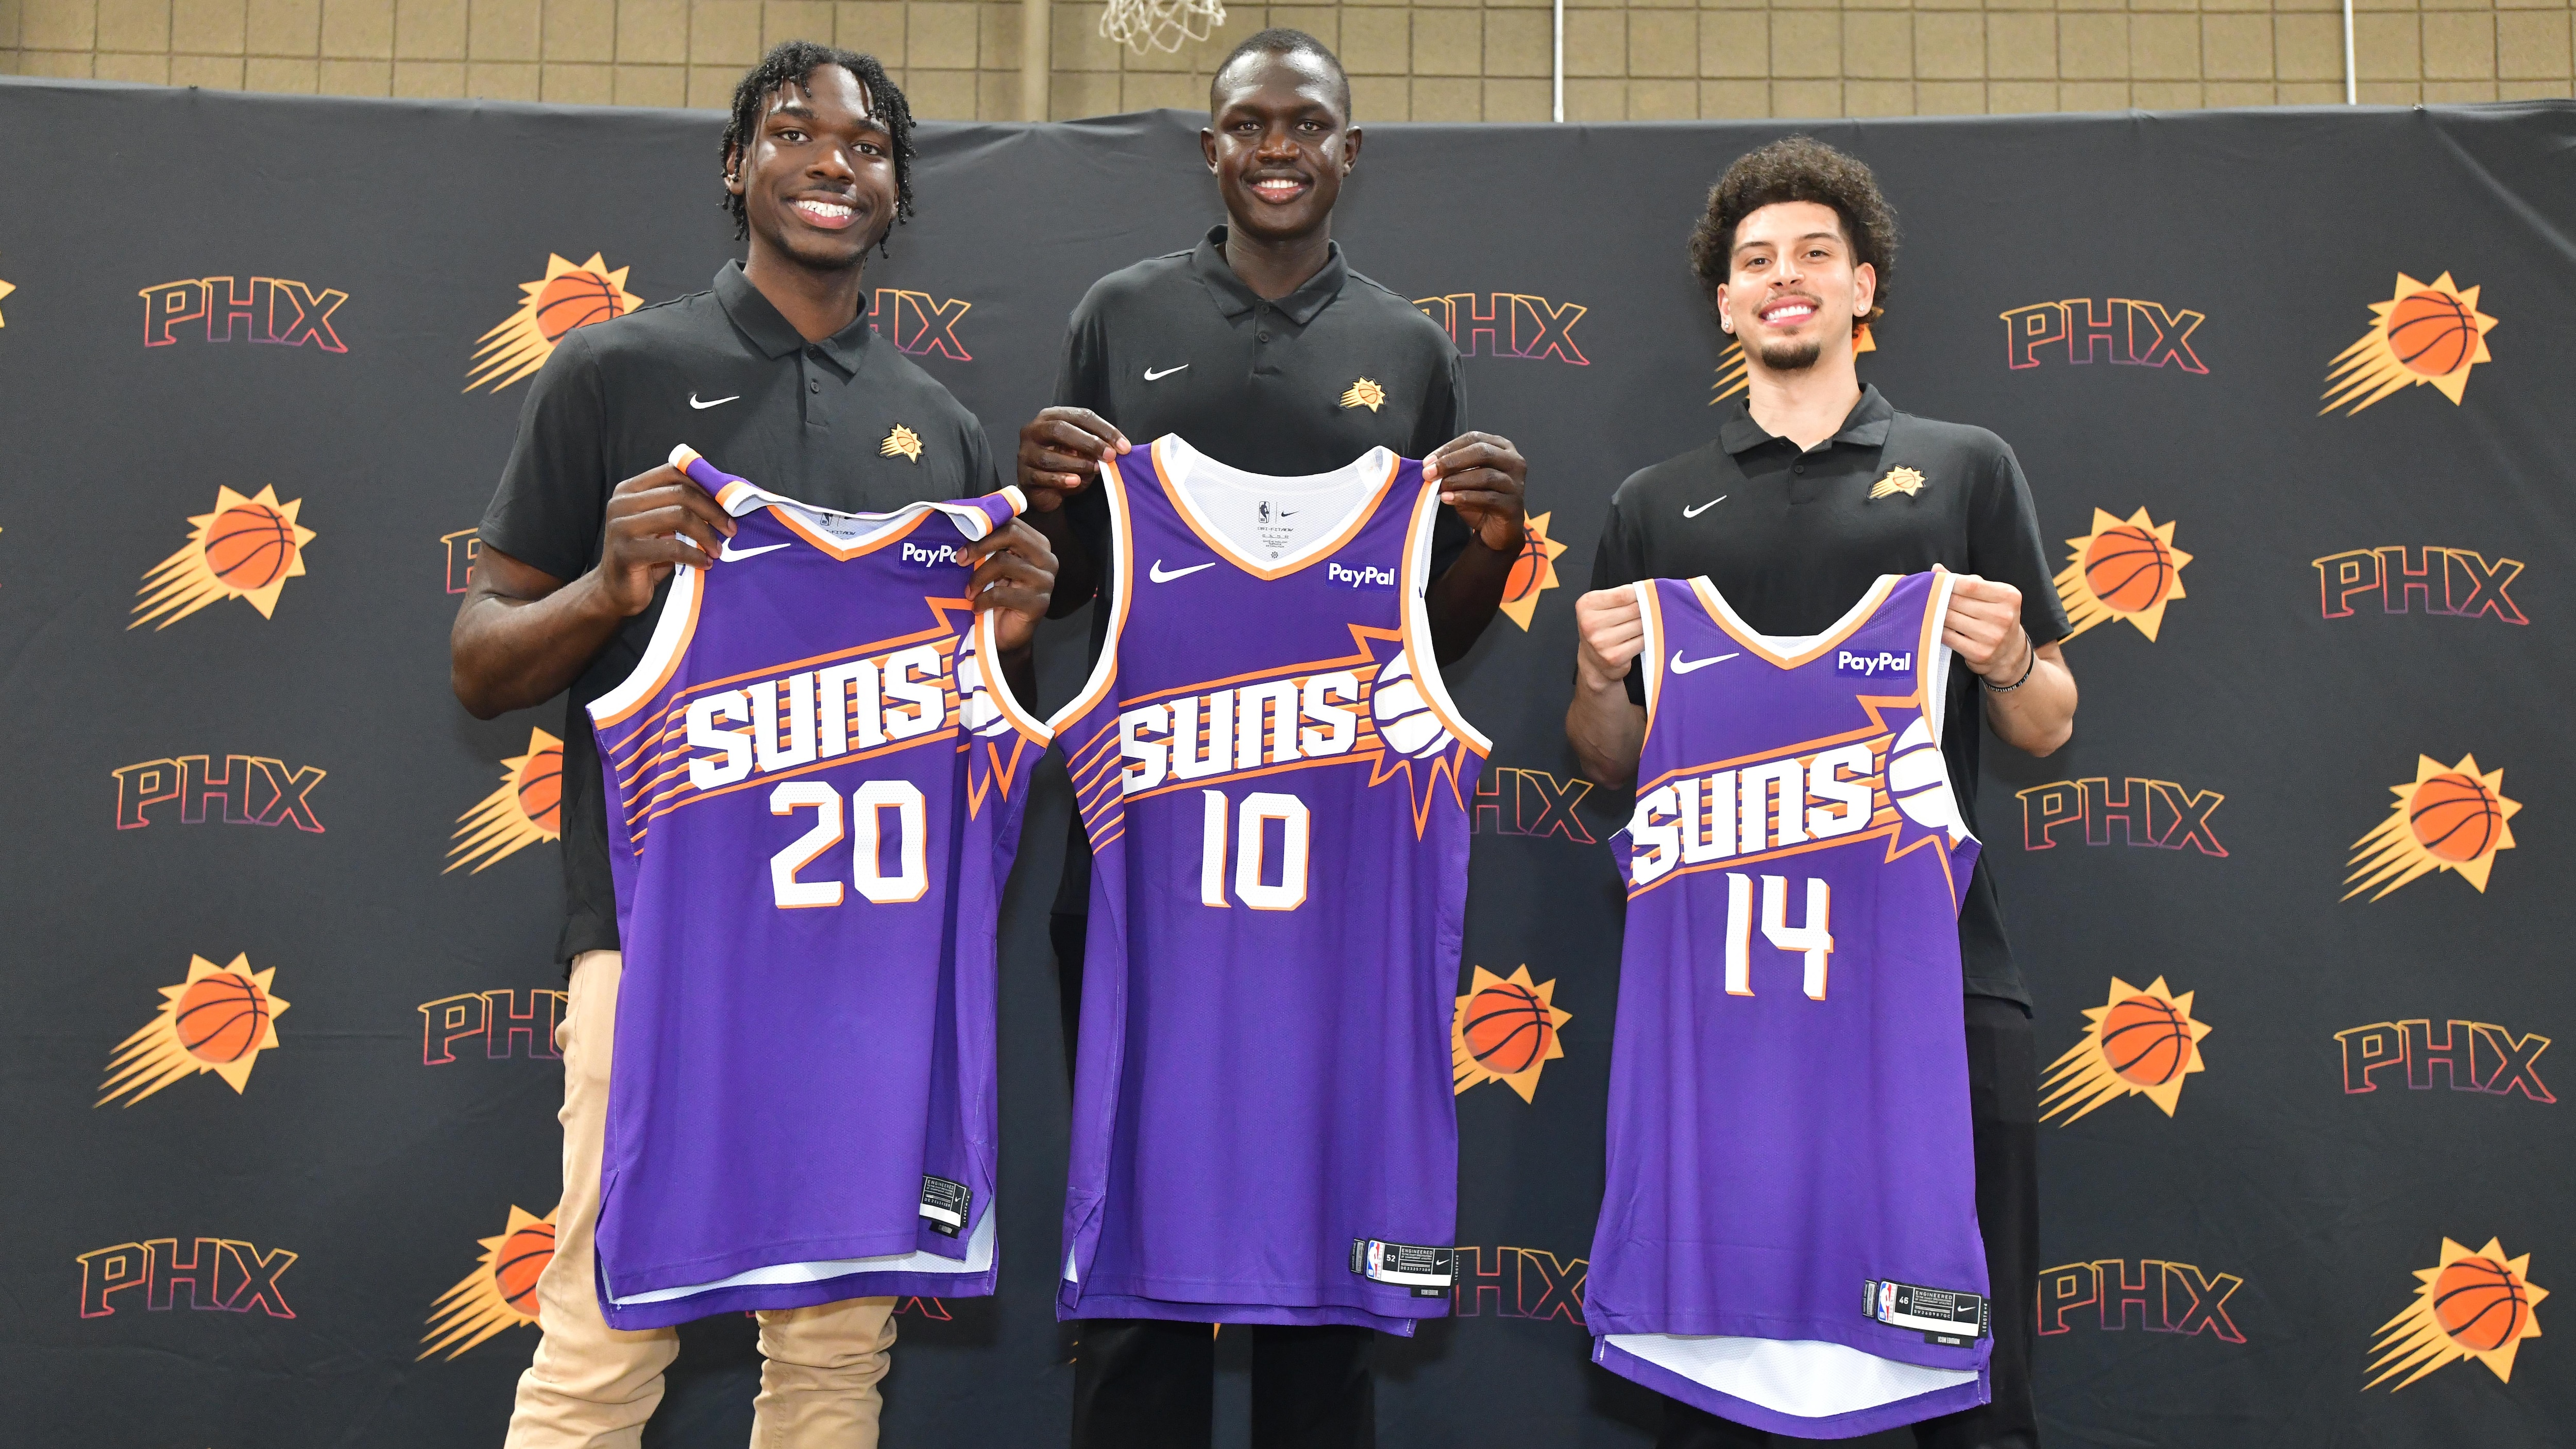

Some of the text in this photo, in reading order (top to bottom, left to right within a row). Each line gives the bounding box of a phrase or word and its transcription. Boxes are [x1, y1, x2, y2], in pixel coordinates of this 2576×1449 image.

[139, 276, 349, 353] PHX
[1999, 298, 2209, 374] PHX
[1329, 562, 1395, 588] PayPal
[2312, 545, 2530, 625] PHX
[1838, 651, 1911, 676] PayPal
[686, 644, 946, 790] SUNS
[1120, 671, 1360, 796] SUNS
[112, 755, 327, 833] PHX
[1632, 743, 1874, 886] SUNS
[2015, 777, 2229, 857] PHX
[770, 780, 928, 909] 20
[1201, 789, 1310, 911] 10
[1725, 873, 1834, 1000] 14
[417, 988, 569, 1065] PH
[2333, 1018, 2556, 1103] PHX
[927, 1180, 954, 1190] ENGINEERED
[76, 1237, 298, 1319] PHX
[1899, 1296, 1909, 1304] 46
[1915, 1290, 1953, 1300] ENGINEERED
[2038, 1258, 2246, 1343] PHX
